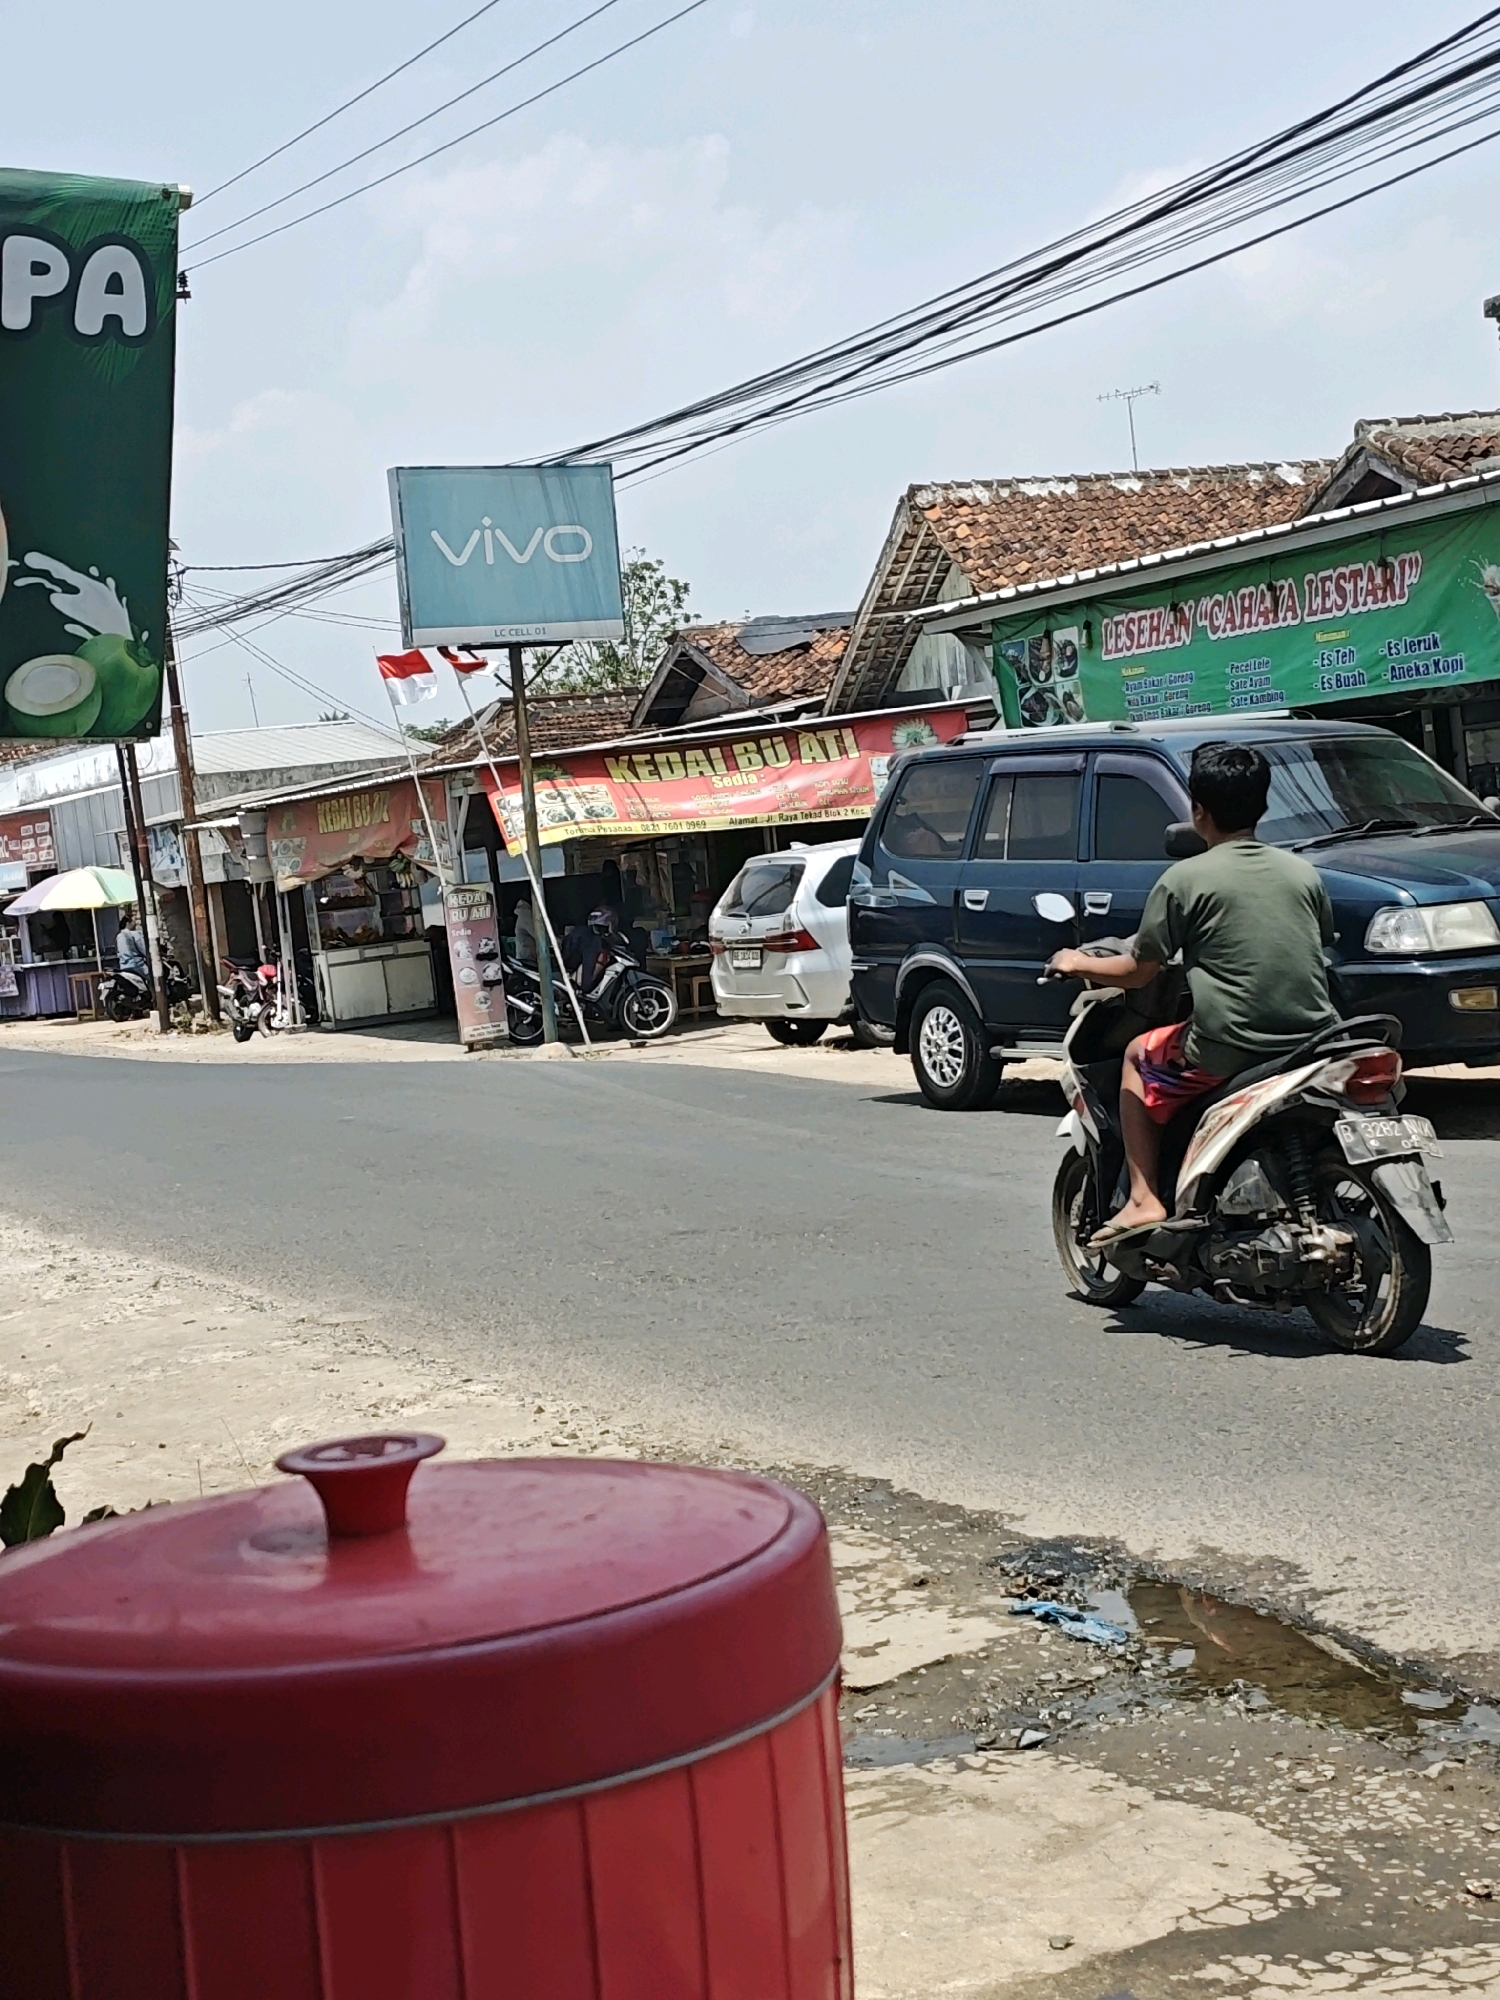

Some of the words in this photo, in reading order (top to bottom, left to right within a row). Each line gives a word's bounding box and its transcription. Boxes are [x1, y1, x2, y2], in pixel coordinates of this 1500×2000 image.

[493, 628, 507, 638] LC
[508, 627, 532, 638] CELL
[534, 626, 547, 636] 01
[1102, 601, 1195, 659] LESEHAN
[1387, 640, 1401, 657] Es
[1403, 633, 1440, 655] Jeruk
[1230, 662, 1252, 675] Pecel
[1253, 658, 1271, 671] Lele
[1320, 651, 1333, 668] Es
[1336, 648, 1355, 665] Teh
[1390, 661, 1430, 681] Aneka
[1432, 654, 1464, 675] Kopi
[1168, 672, 1194, 686] Goreng
[1230, 679, 1248, 691] Sate
[1249, 675, 1271, 689] Ayam
[1320, 675, 1333, 690] Es
[1336, 671, 1366, 689] Buah
[1230, 696, 1248, 708] Sate
[1249, 690, 1285, 705] Kambing
[604, 746, 728, 783] KEDAI
[732, 736, 792, 772] BU
[798, 728, 861, 764] ATI
[711, 772, 757, 789] Sedia
[729, 814, 759, 826] Alamat
[778, 811, 798, 822] Raya
[448, 890, 487, 908] KEDAI
[451, 907, 468, 923] BU
[470, 905, 492, 920] ATI
[1339, 1124, 1354, 1143] B
[1361, 1120, 1403, 1139] 3282
